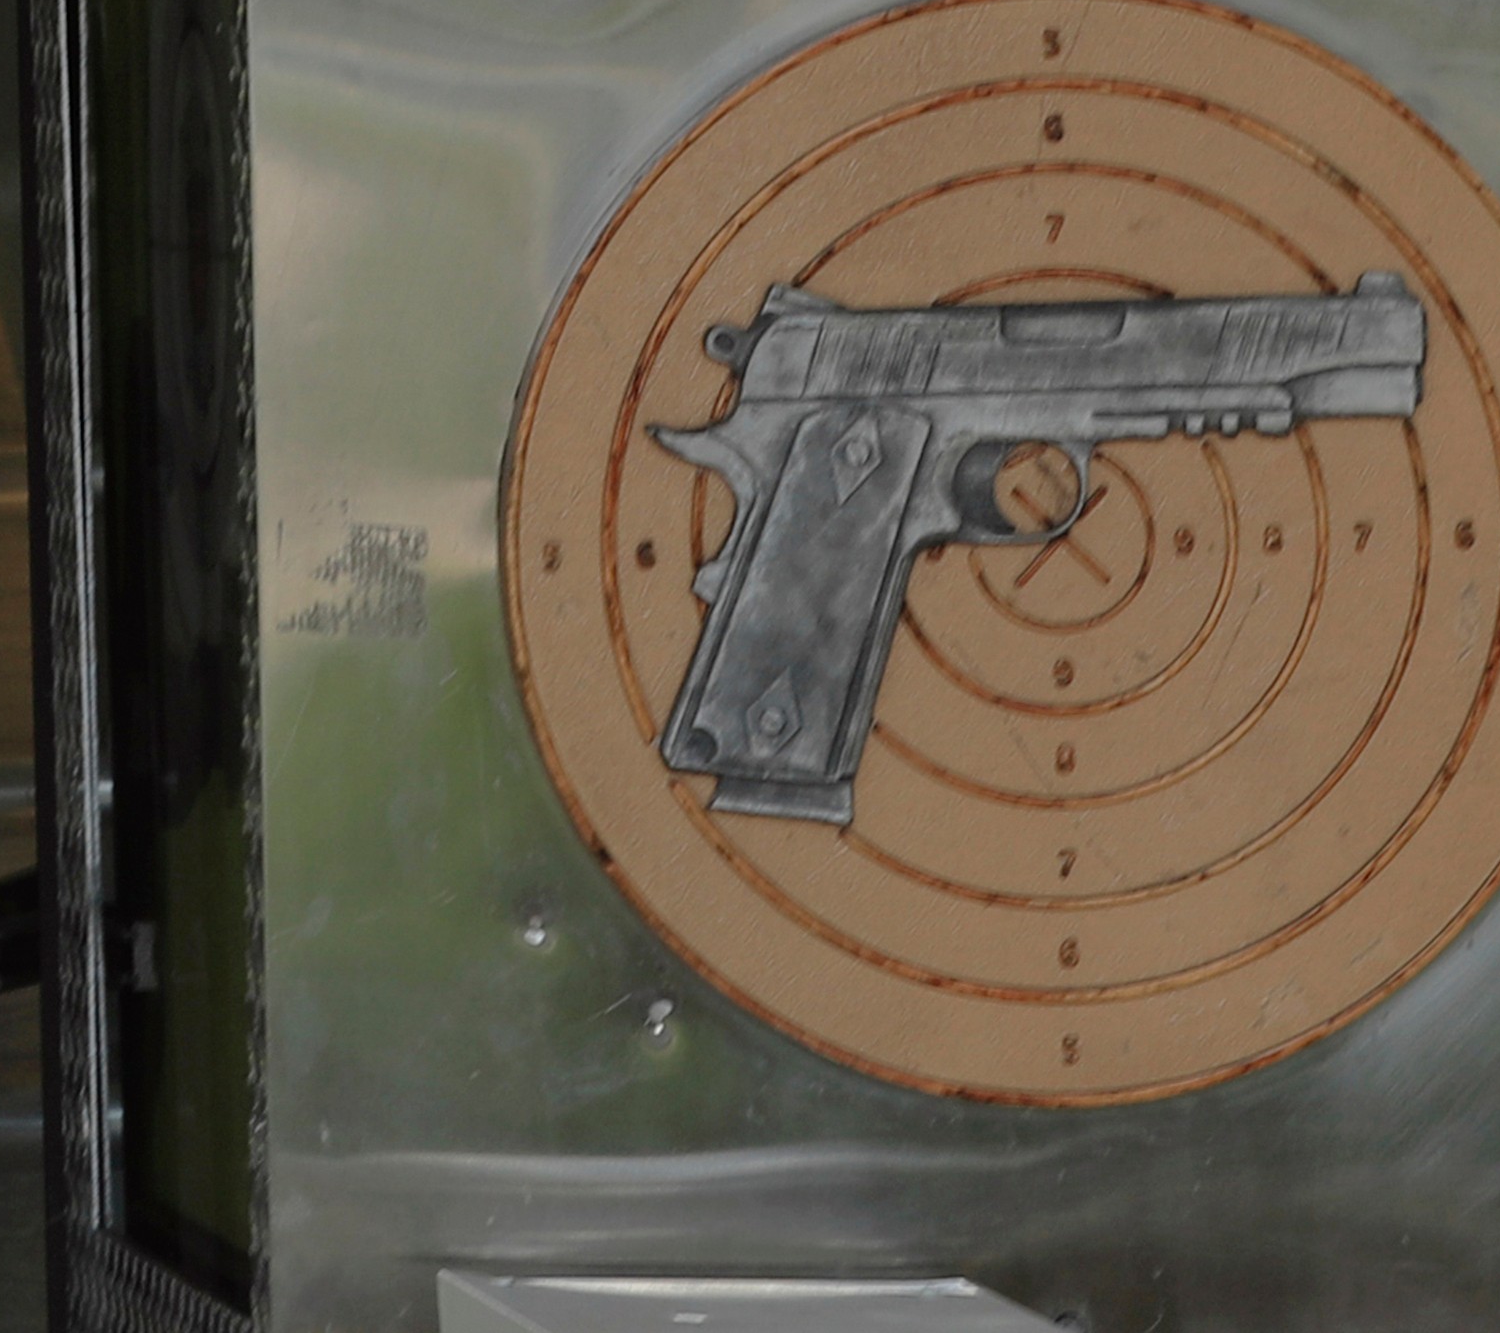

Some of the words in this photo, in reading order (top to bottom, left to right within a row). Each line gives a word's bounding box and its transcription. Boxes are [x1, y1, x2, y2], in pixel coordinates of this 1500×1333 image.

[1044, 213, 1066, 245] 7
[1353, 521, 1374, 555] 7
[1056, 847, 1078, 880] 7
[1057, 936, 1081, 970] 6
